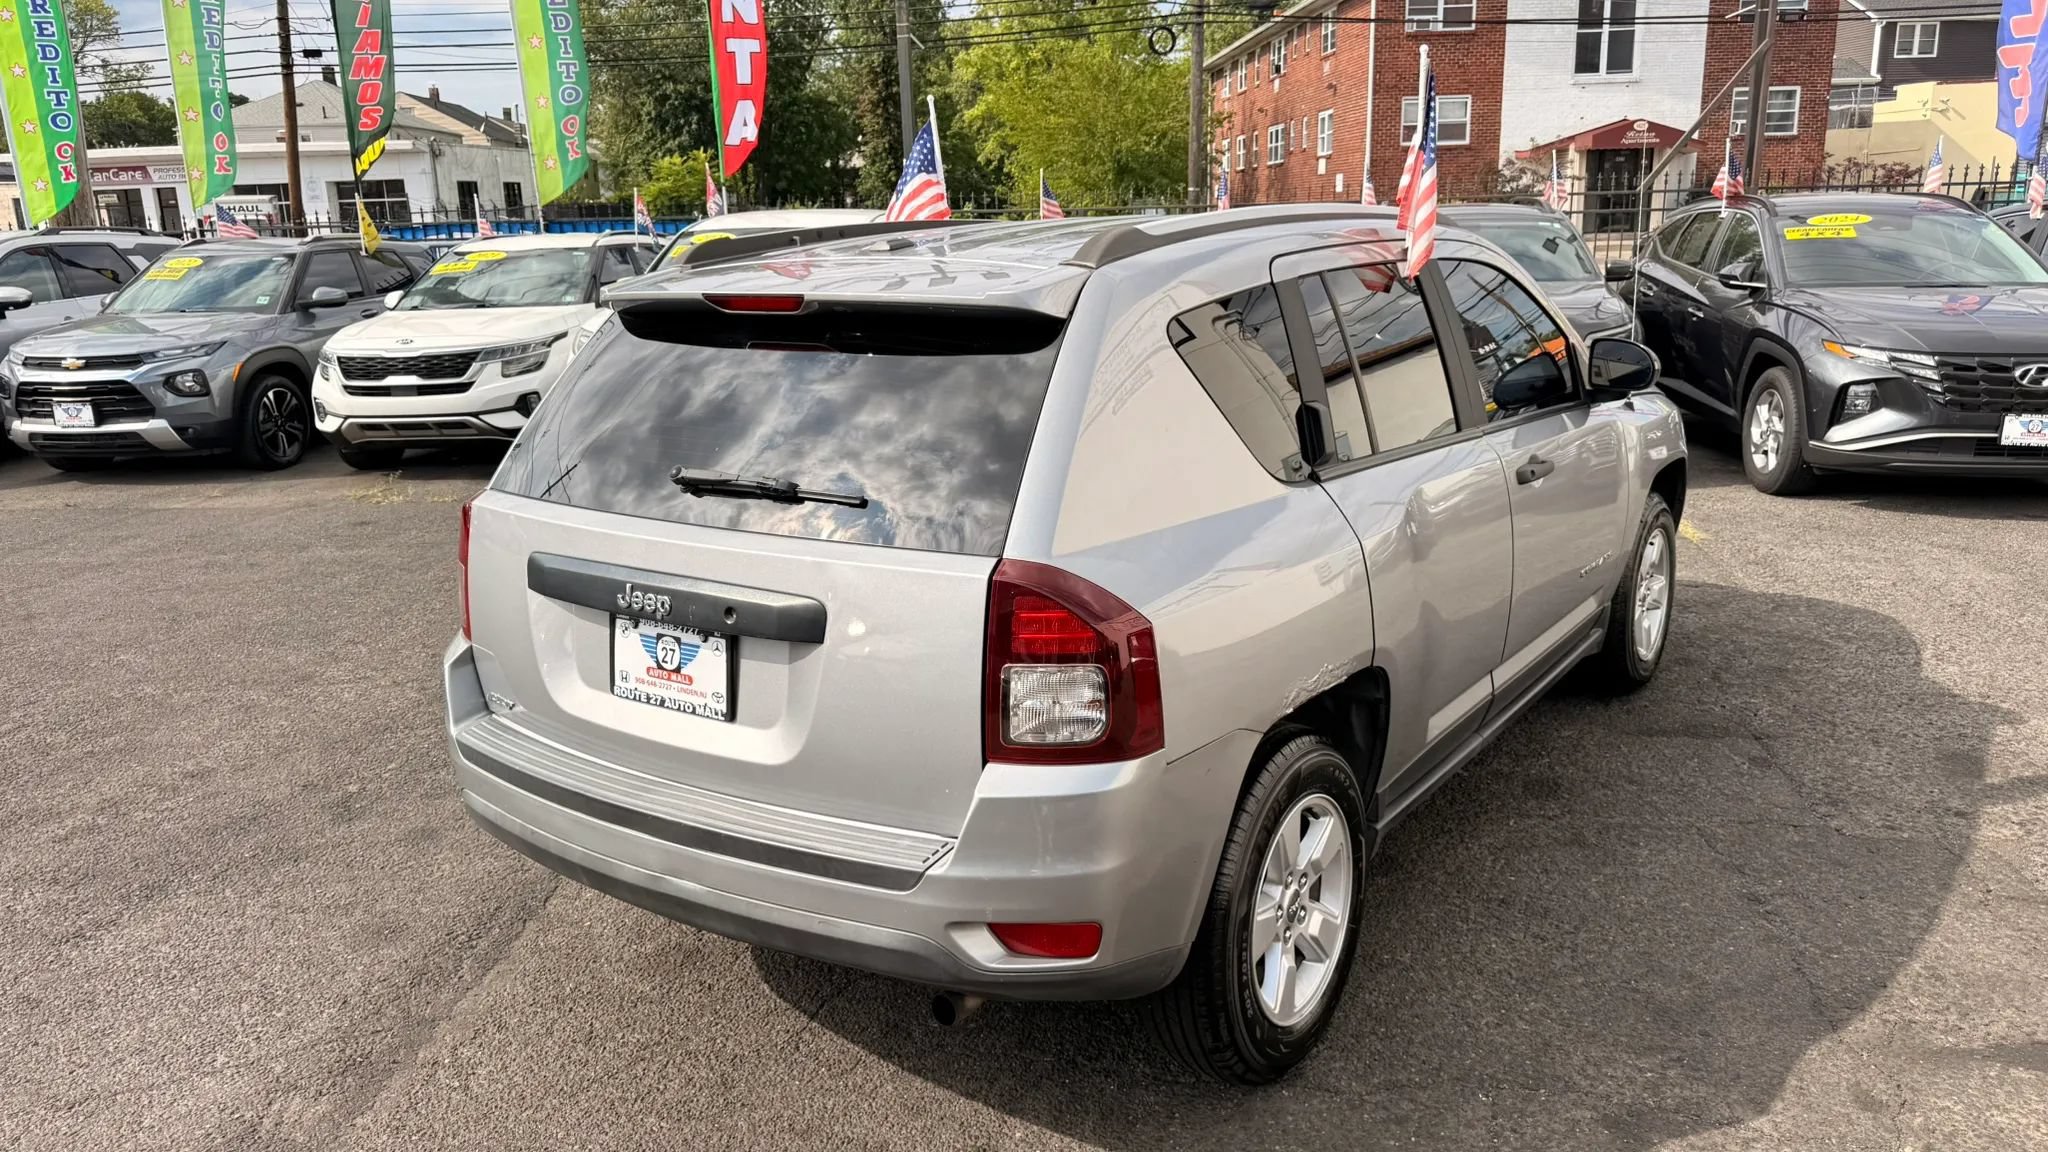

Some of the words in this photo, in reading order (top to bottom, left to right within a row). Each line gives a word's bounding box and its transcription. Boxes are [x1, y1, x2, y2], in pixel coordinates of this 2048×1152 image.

[348, 0, 388, 131] IAMOS
[201, 0, 225, 122] EDITO
[213, 131, 233, 174] OK
[55, 141, 77, 183] OK
[617, 583, 672, 620] Jeep
[660, 639, 677, 647] ROUTE
[661, 646, 677, 666] 27
[648, 667, 670, 679] AUTO
[672, 672, 693, 684] MALL
[614, 686, 648, 702] ROUTE
[649, 693, 662, 706] 27
[663, 697, 694, 713] AUTO
[695, 704, 726, 720] MALL
